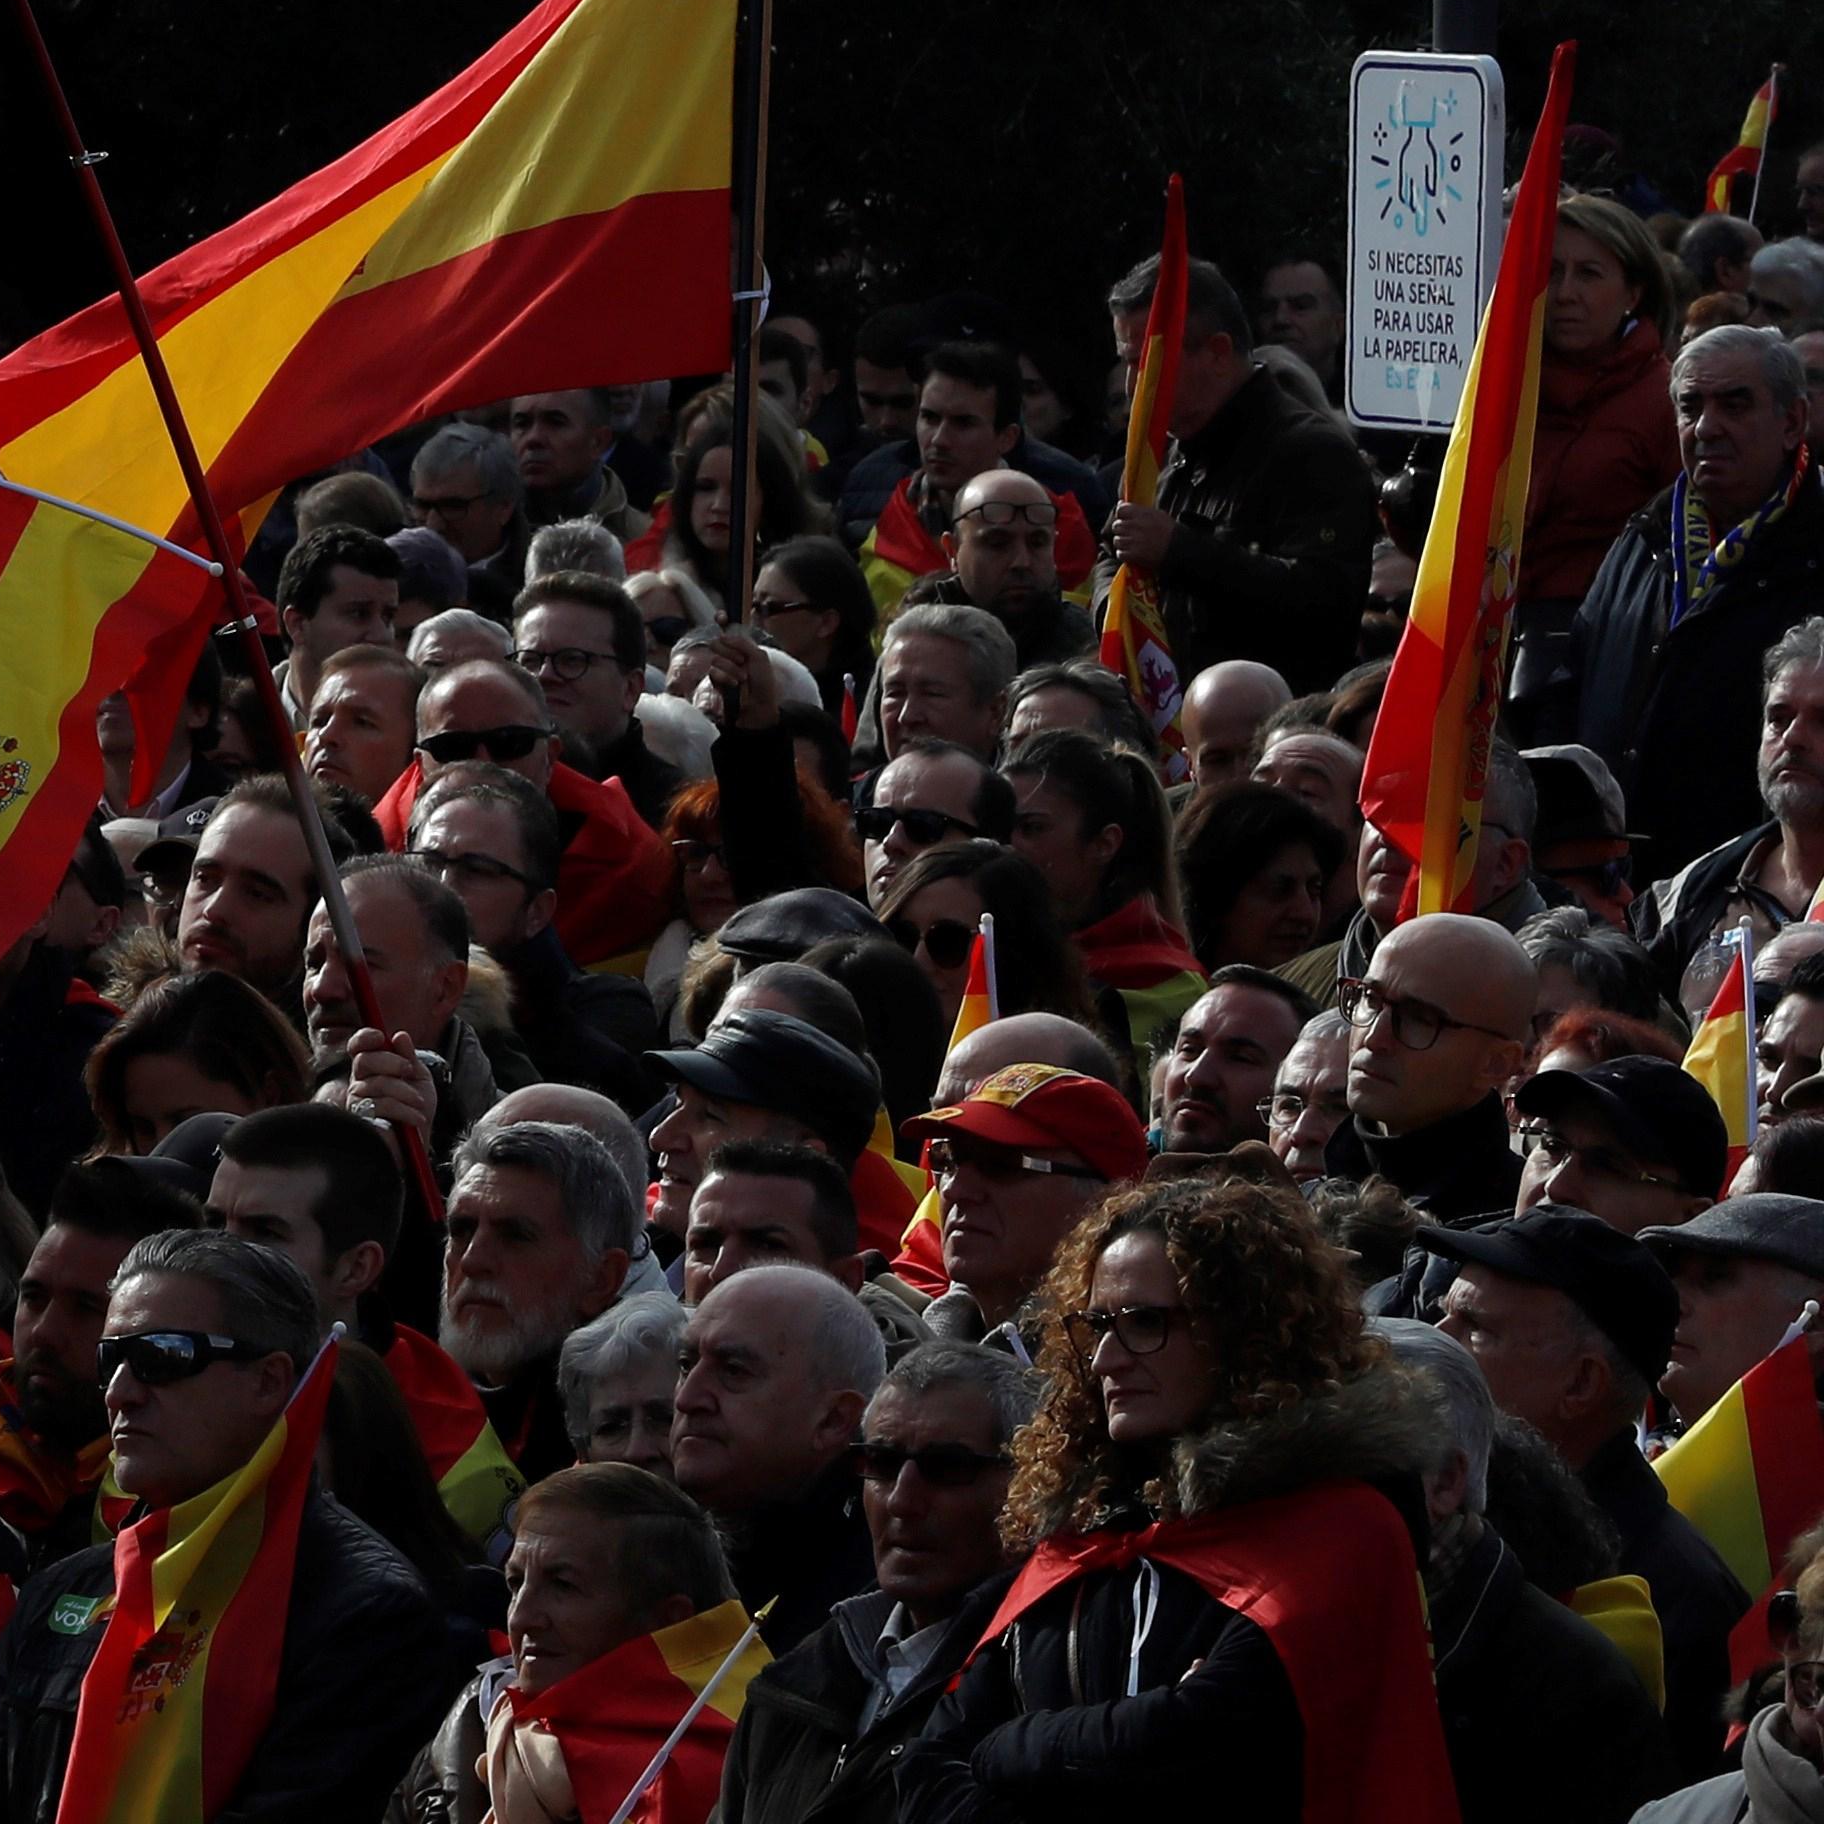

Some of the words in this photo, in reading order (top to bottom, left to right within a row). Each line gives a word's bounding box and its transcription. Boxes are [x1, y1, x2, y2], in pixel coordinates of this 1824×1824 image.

[1368, 250, 1381, 271] SI
[1386, 251, 1463, 278] NECESITAS
[1374, 279, 1405, 303] UNA
[1409, 278, 1455, 306] SEÑAL
[1374, 308, 1412, 333] PARA
[1416, 311, 1454, 335] USAR
[1364, 336, 1381, 358] LA
[1386, 339, 1463, 368] PAPELERA,
[54, 1610, 87, 1627] VOX
